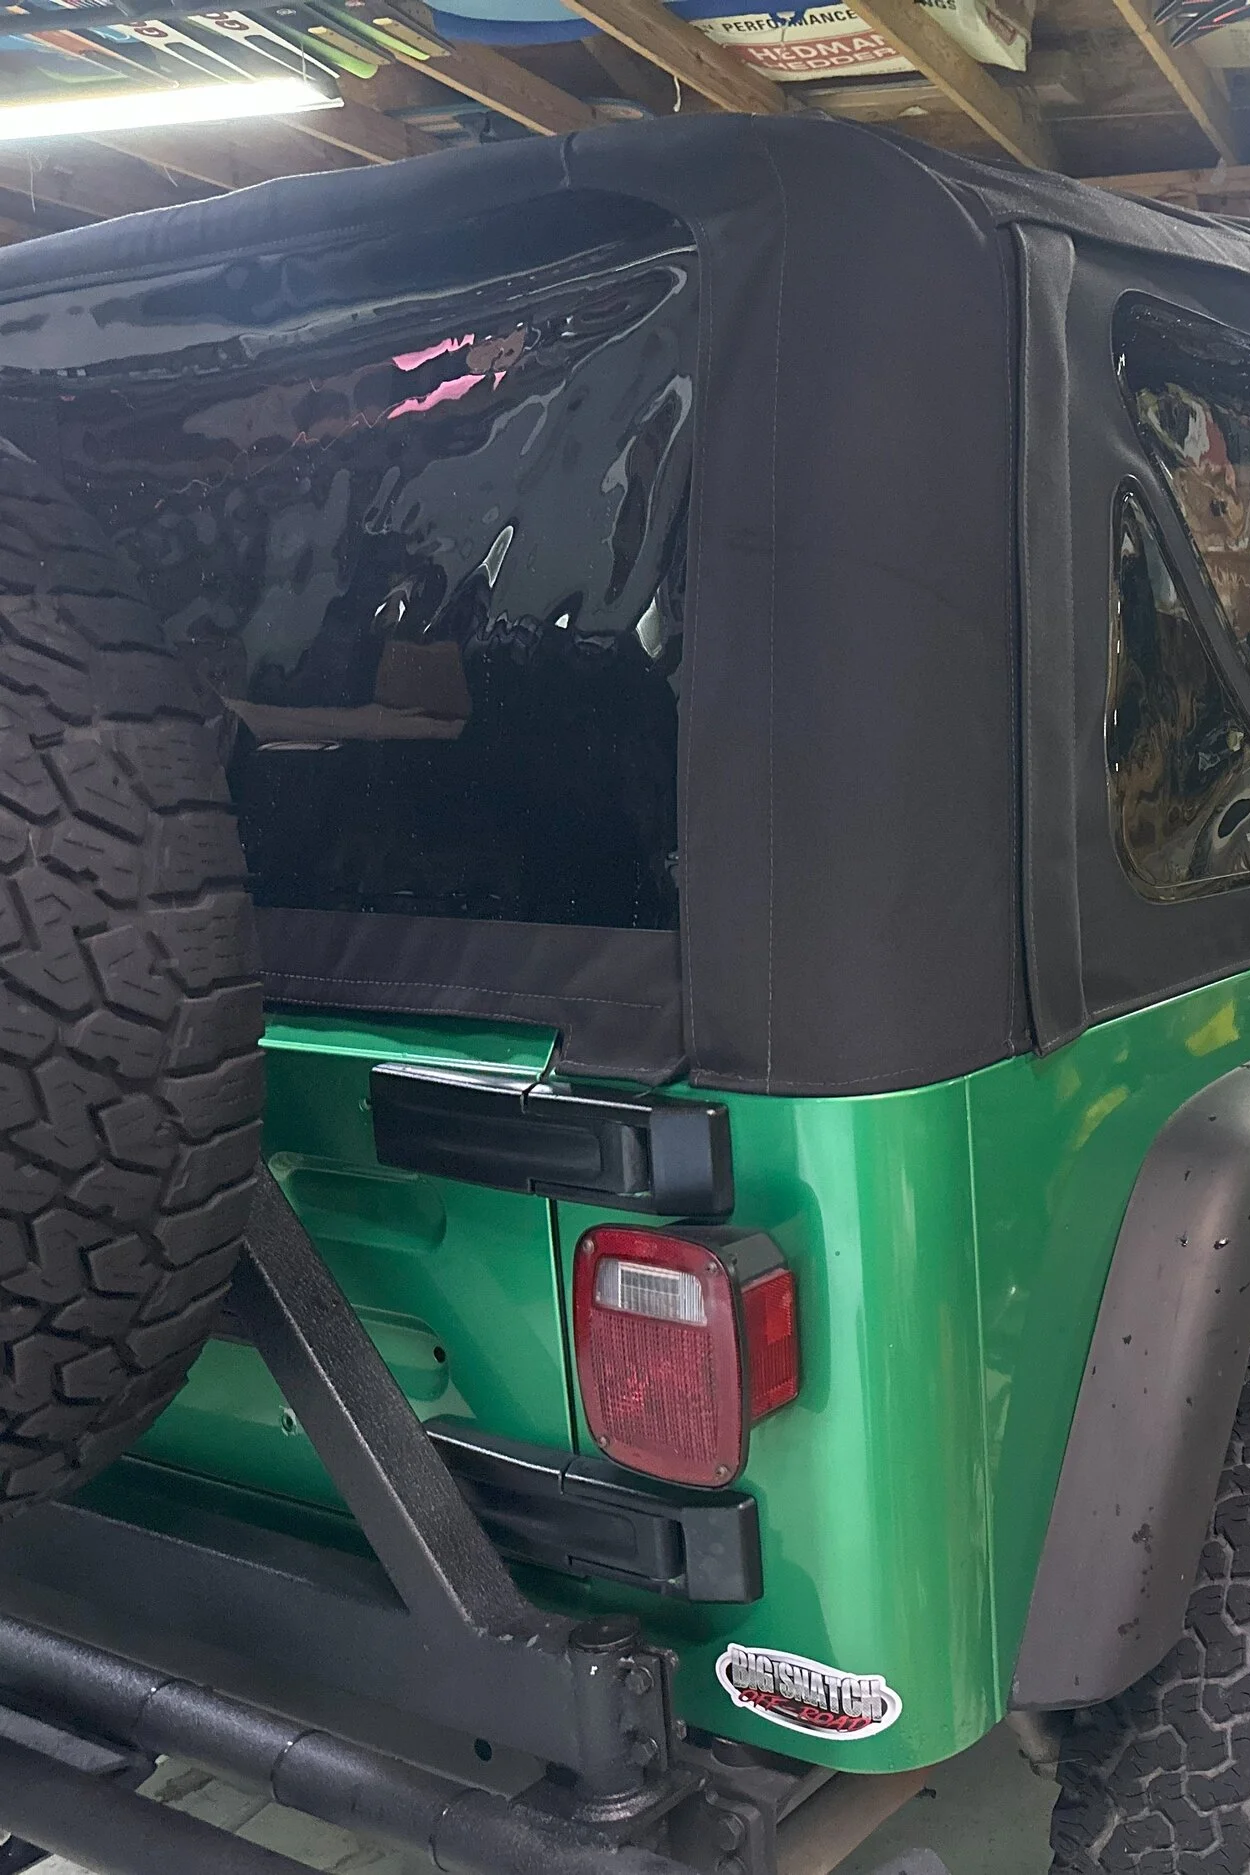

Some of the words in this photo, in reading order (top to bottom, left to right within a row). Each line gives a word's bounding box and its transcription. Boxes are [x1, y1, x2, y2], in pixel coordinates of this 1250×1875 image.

[721, 9, 859, 33] PERFOMANCE
[731, 1648, 774, 1694] BIG
[778, 1661, 883, 1722] SNATCH
